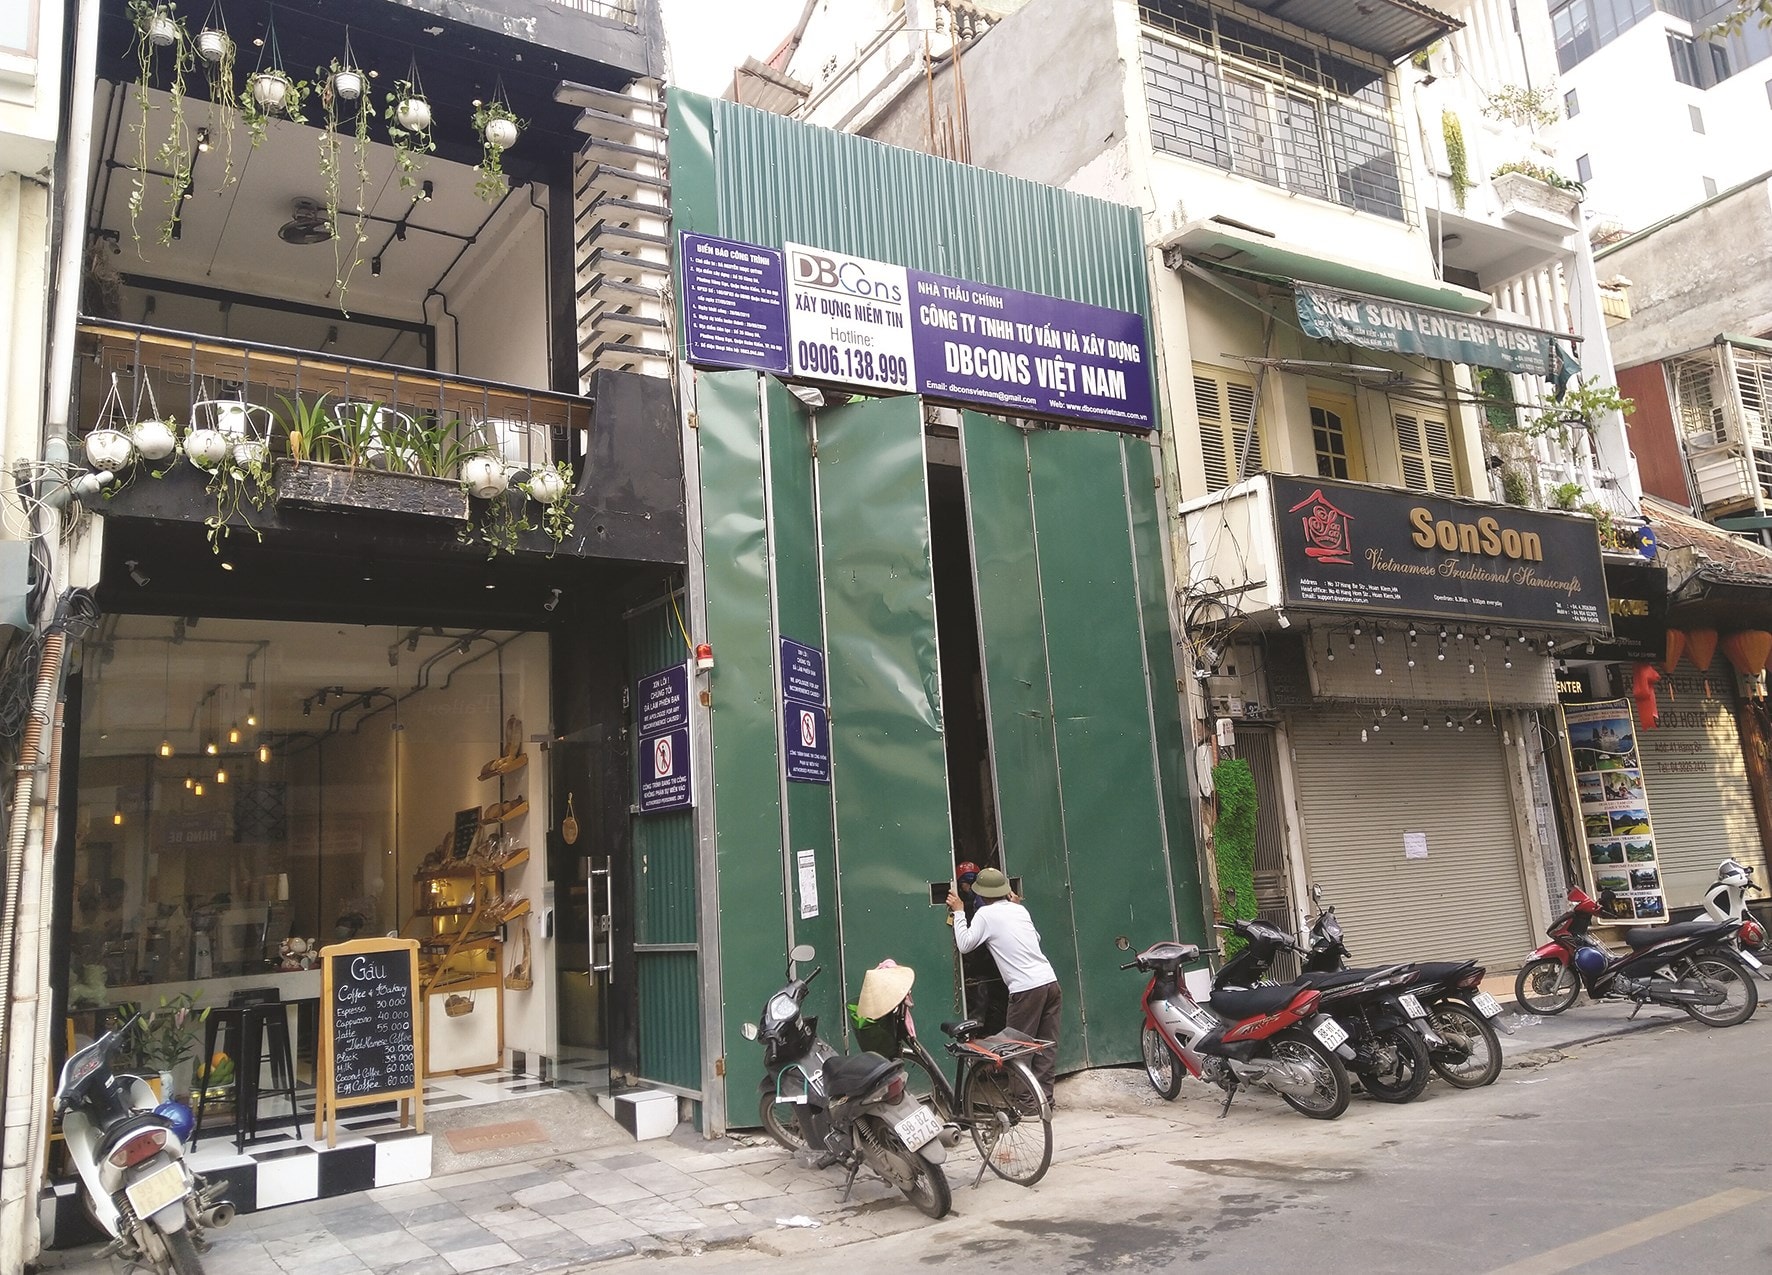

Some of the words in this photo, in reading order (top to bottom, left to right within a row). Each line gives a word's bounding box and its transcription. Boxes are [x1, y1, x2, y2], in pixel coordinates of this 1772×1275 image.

[795, 292, 816, 312] XÂY
[821, 298, 850, 320] DỰNG
[885, 310, 903, 328] TIN
[918, 281, 940, 296] NHÀ
[942, 285, 970, 302] THẦU
[972, 292, 1004, 309] CHÍNH
[830, 327, 874, 346] Hotline:
[920, 304, 957, 330] CÔNG
[960, 313, 976, 333] TY
[979, 316, 1014, 340] TNHH
[1016, 323, 1035, 344] TƯ
[1035, 323, 1061, 349] VẤN
[1063, 329, 1080, 352] VÀ
[1081, 332, 1107, 356] XÂY
[1108, 340, 1140, 364] DỰNG
[1367, 304, 1412, 331] SON
[1417, 312, 1540, 354] ENTERPRISE
[799, 340, 907, 385] 0906.138.999
[945, 341, 1030, 385] DBCONS
[1034, 355, 1076, 398] VIỆT
[1081, 366, 1126, 400] NAM
[926, 380, 947, 391] Email:
[949, 384, 1036, 404] dbconsvietnam@gmail.com
[1049, 400, 1065, 408] Web:
[1066, 403, 1147, 420] www.dbconsvietnam.com.vn
[1410, 508, 1543, 562] SonSon
[1364, 548, 1435, 576] Vietnamese
[1438, 559, 1511, 584] Traditional
[1513, 567, 1582, 598] Handicrafts
[338, 985, 366, 1004] Coffee
[906, 1121, 940, 1148] 557.49
